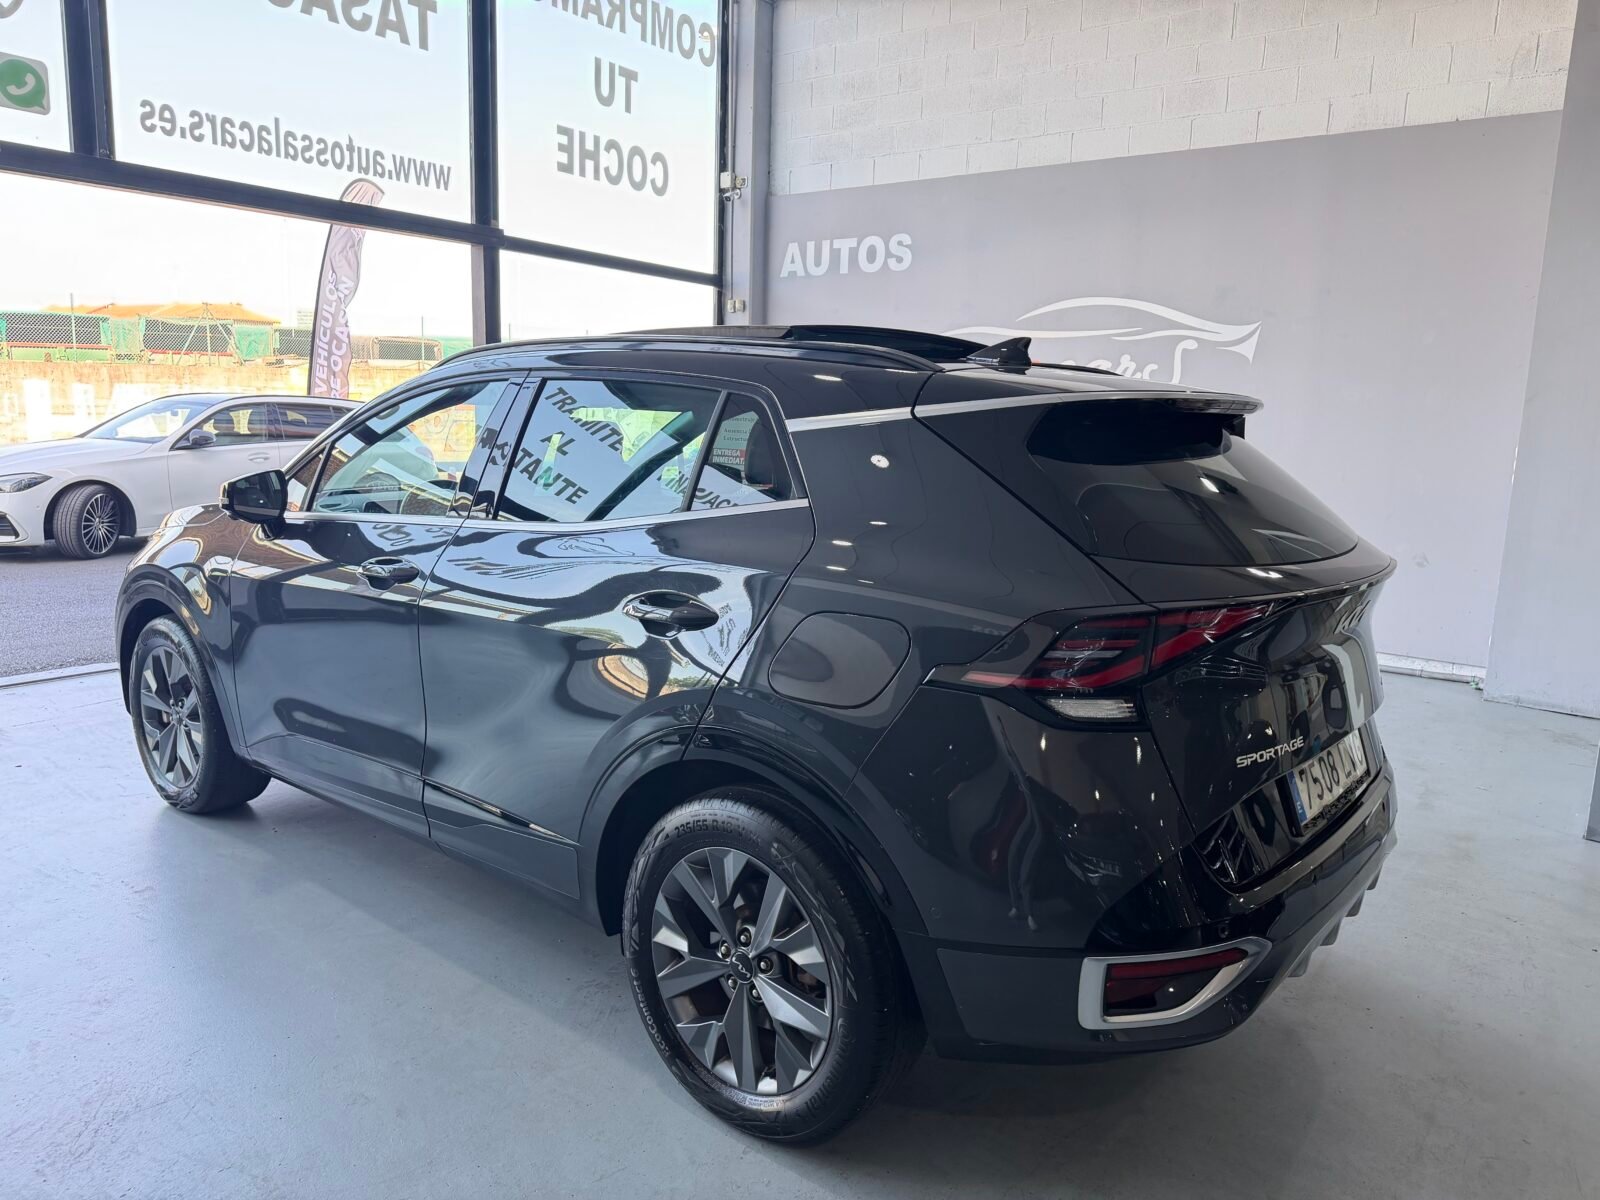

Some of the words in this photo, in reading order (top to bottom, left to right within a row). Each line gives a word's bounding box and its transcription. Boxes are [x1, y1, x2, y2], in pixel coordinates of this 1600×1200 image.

[780, 233, 912, 278] AUTOS
[712, 457, 745, 465] INMEDIAT
[1235, 735, 1305, 768] SPORTAGE
[1298, 749, 1340, 810] 7508
